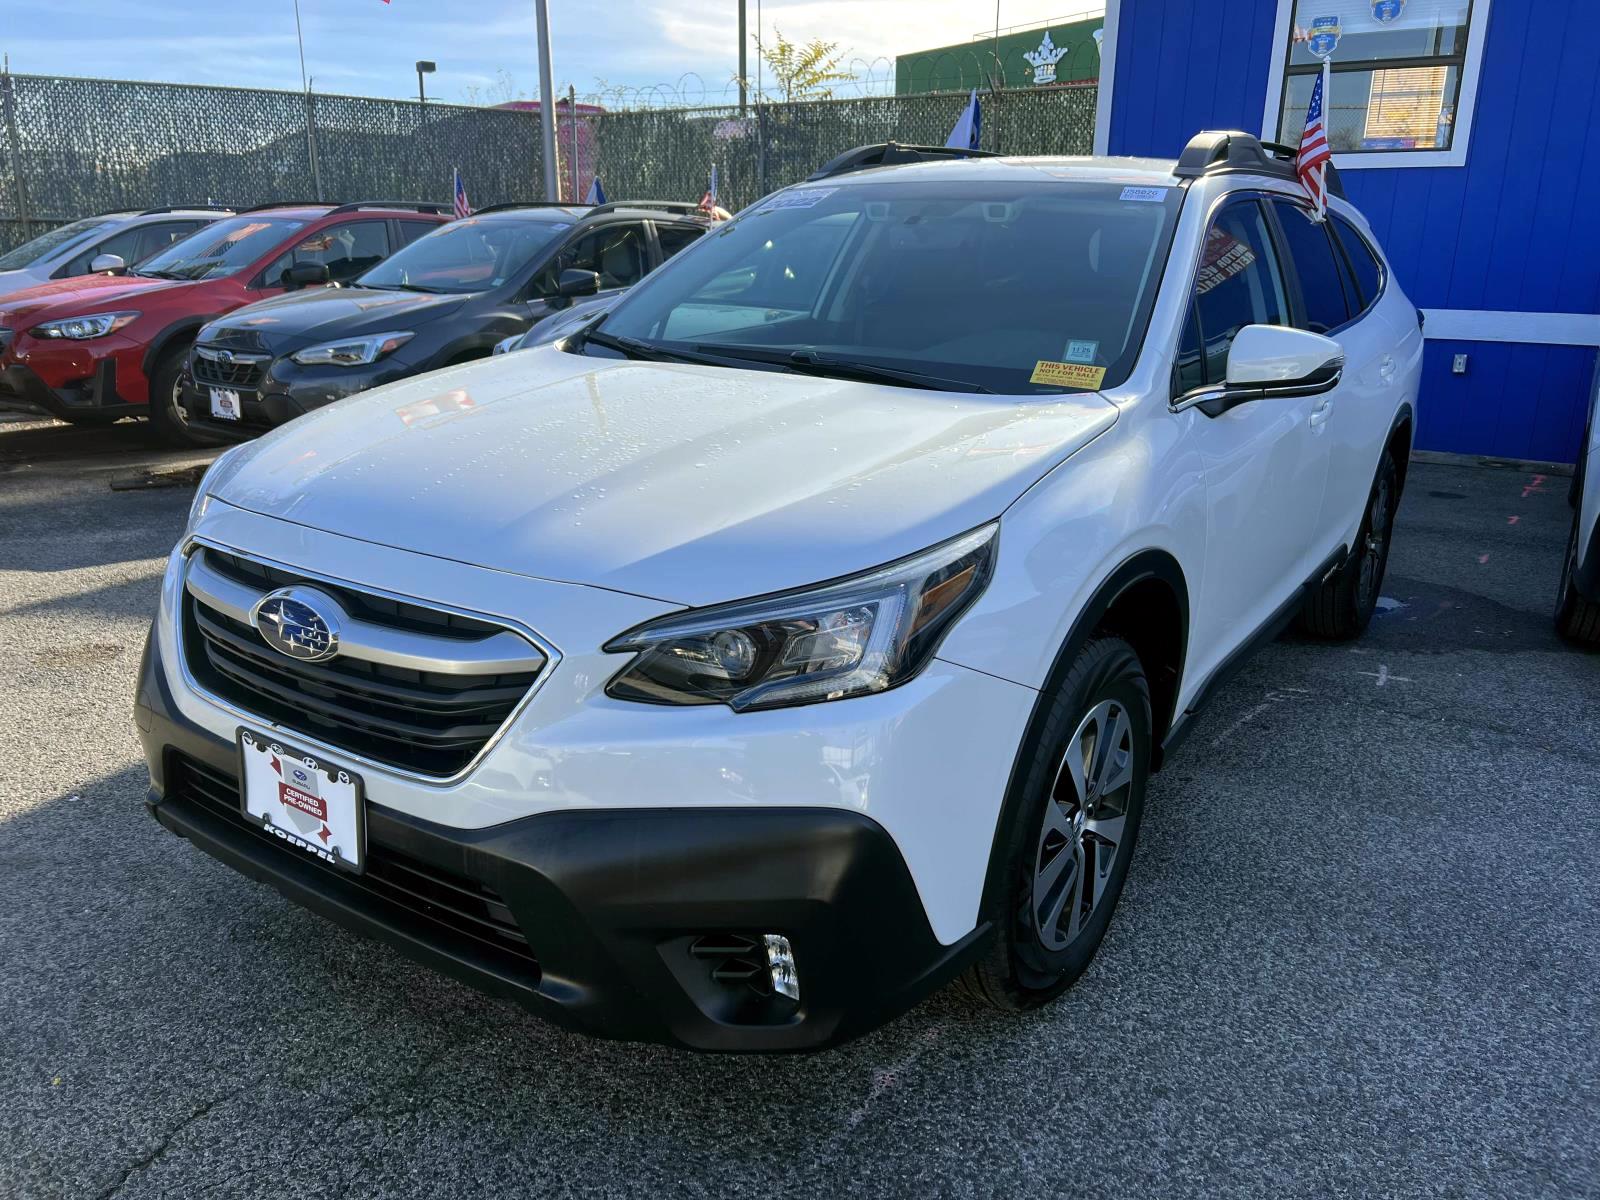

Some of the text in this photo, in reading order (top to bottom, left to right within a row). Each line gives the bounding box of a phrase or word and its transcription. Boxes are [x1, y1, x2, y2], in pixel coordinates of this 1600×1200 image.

[1040, 362, 1100, 374] THIS VEHICLE
[283, 793, 323, 816] PRE-OWNED
[286, 788, 319, 807] CERTIFIED
[263, 823, 336, 864] KOEPPEL
